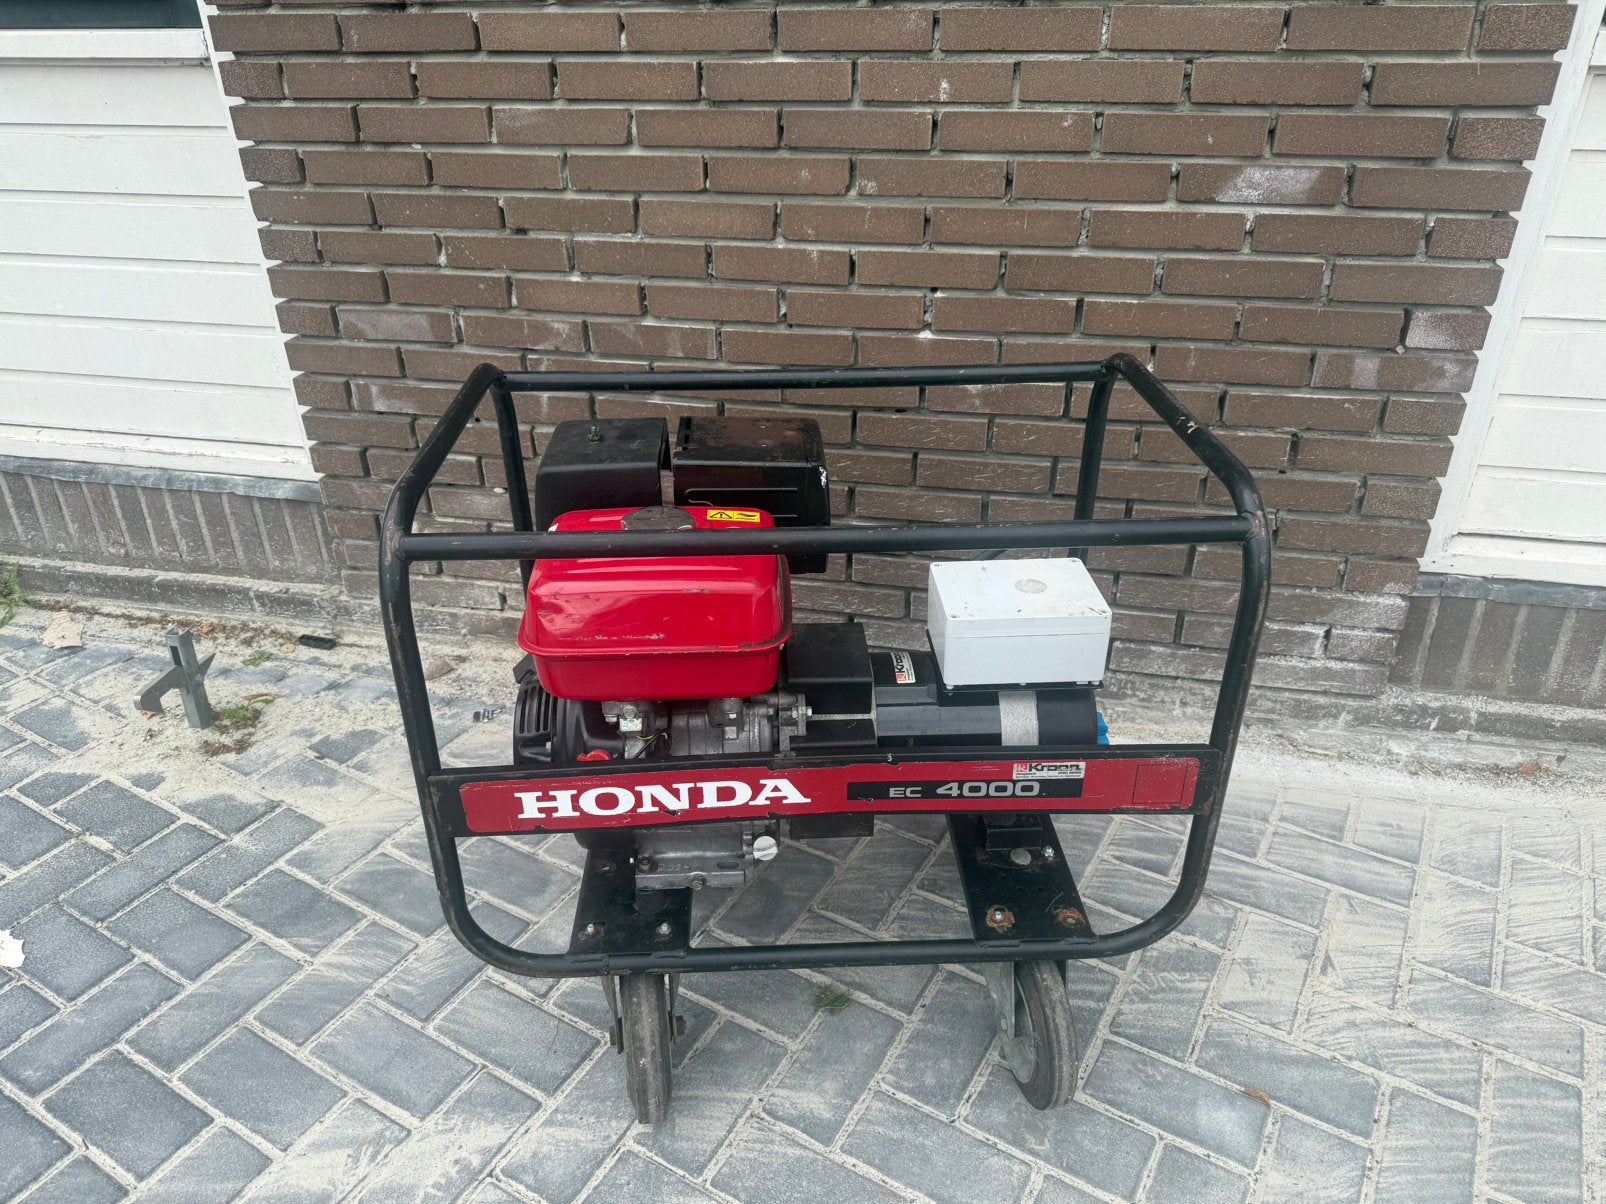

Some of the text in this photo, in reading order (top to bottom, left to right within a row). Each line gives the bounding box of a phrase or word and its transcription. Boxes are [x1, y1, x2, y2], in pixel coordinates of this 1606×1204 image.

[514, 778, 812, 819] HONDA
[889, 781, 1040, 798] EC 4000
